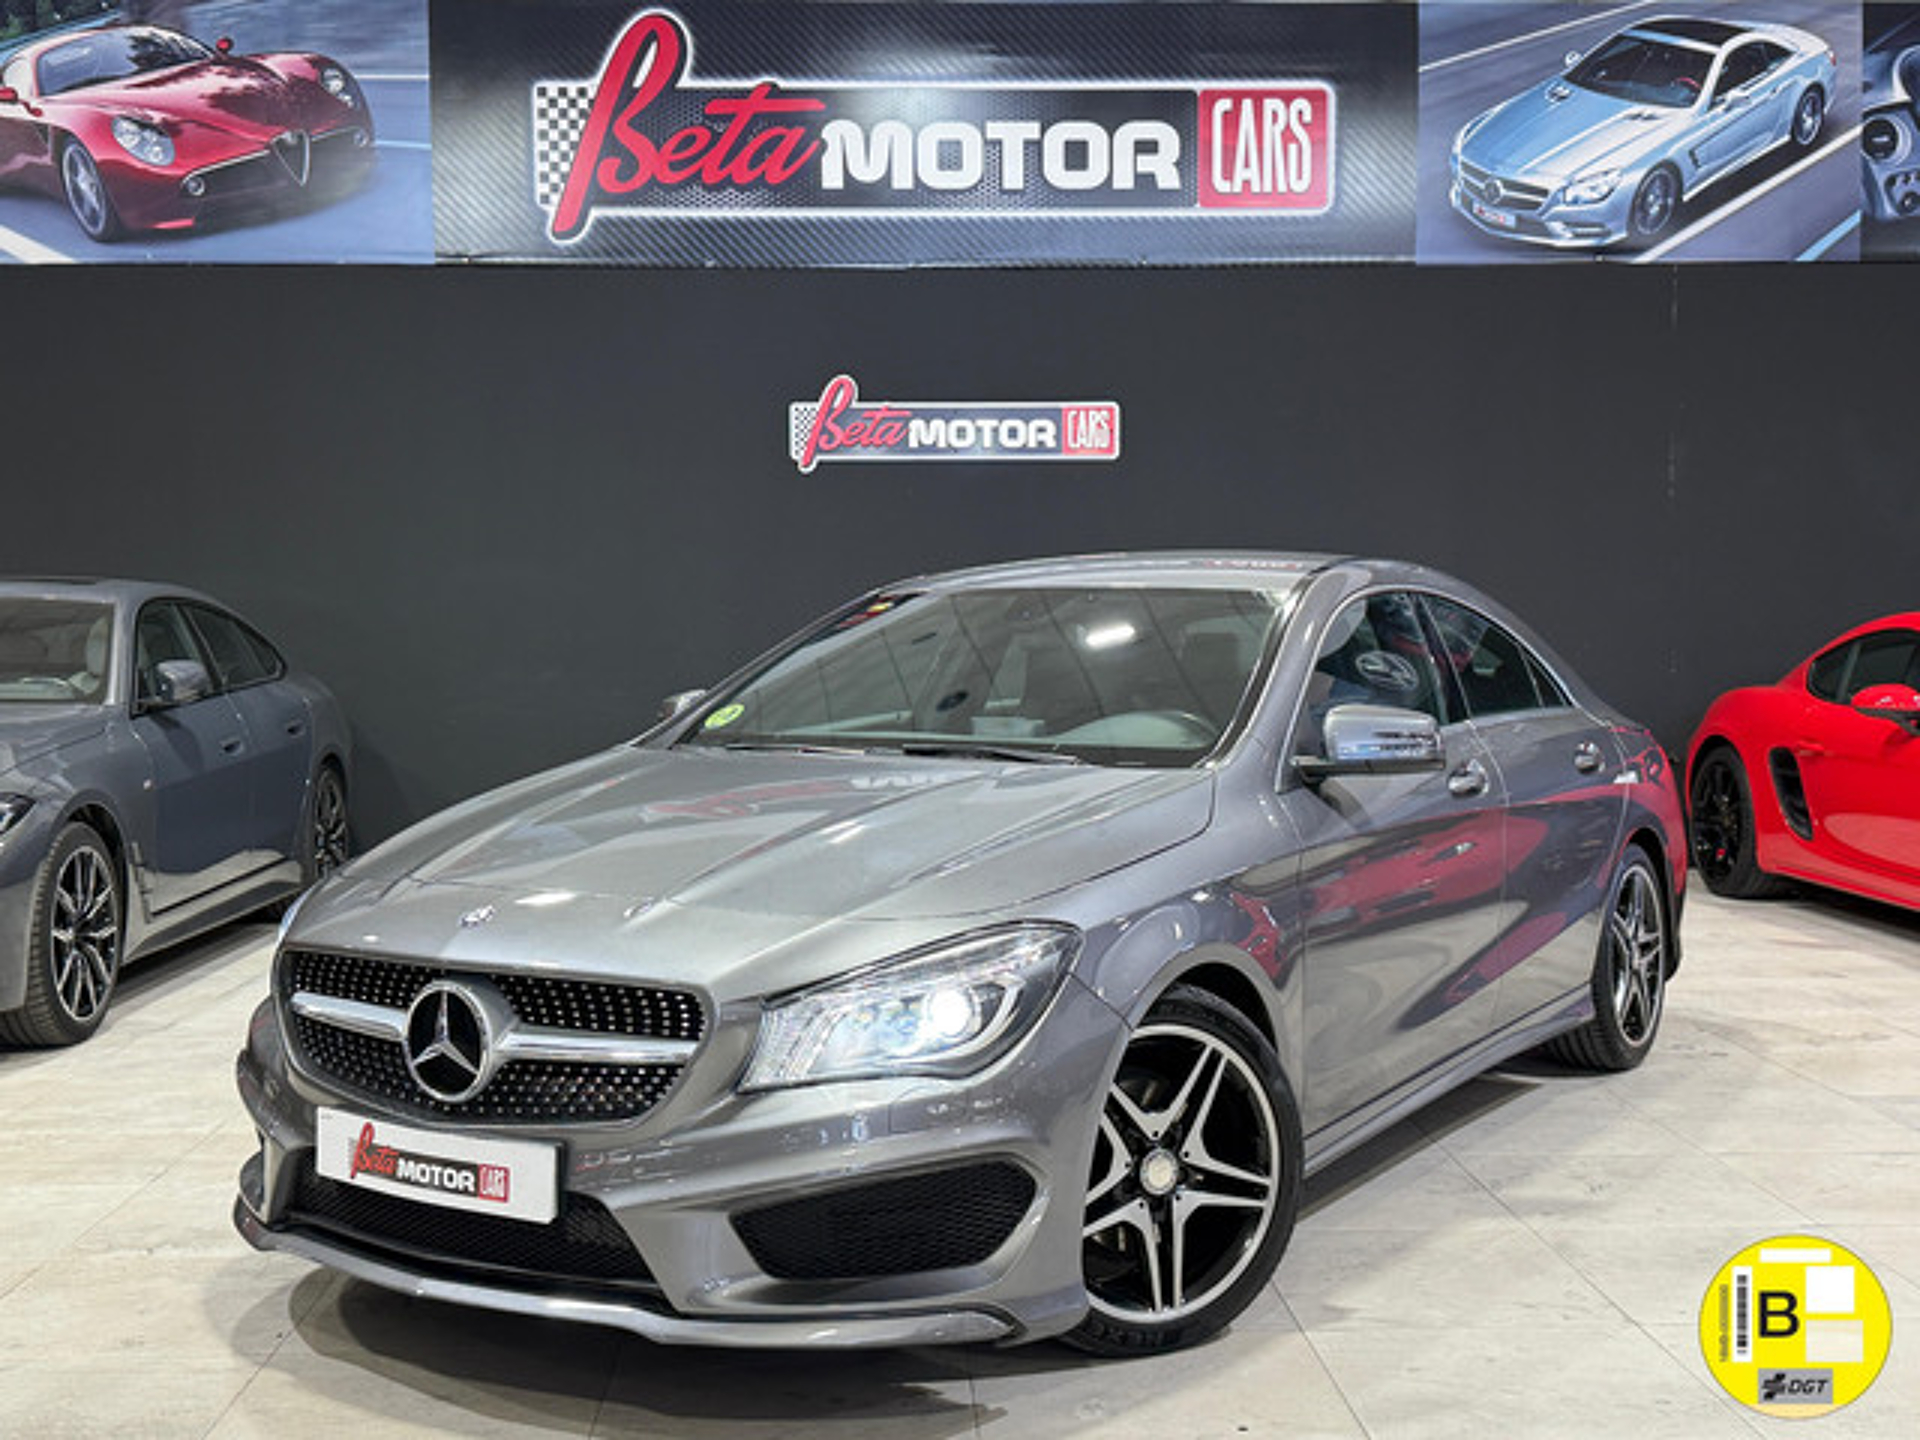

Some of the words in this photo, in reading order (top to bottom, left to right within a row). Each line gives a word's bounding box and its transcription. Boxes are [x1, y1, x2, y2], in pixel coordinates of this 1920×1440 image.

[553, 13, 826, 233] Beta
[821, 120, 1181, 190] MOTOR
[1211, 98, 1313, 194] CARS
[801, 377, 912, 467] Beta
[907, 419, 1056, 448] MOTOR
[1067, 409, 1110, 450] CARS
[397, 1159, 475, 1191] MOTOR
[481, 1165, 507, 1198] CARS
